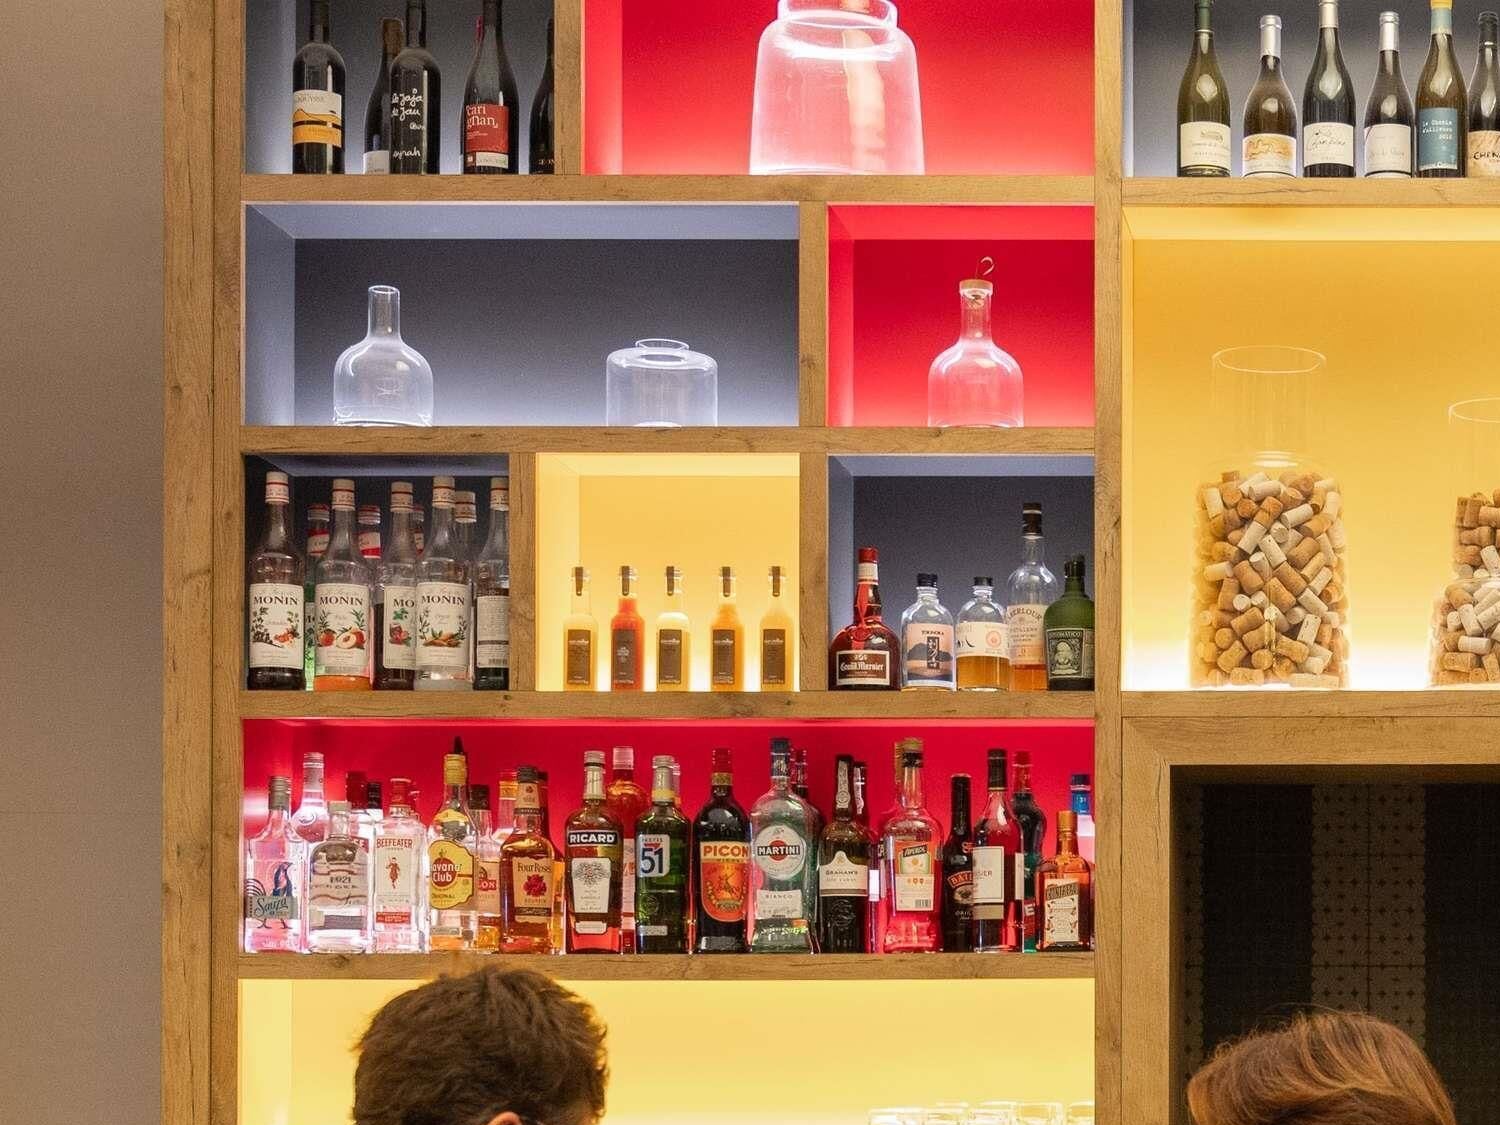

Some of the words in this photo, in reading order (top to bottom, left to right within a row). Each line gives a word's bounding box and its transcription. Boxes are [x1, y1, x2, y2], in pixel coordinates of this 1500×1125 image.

[254, 596, 298, 606] MONIN
[320, 596, 363, 606] MONIN
[422, 595, 465, 606] MONIN
[376, 838, 413, 849] BEEFEATER
[569, 833, 615, 844] RICARD
[703, 845, 749, 857] PICON
[758, 846, 800, 855] MARTINI
[640, 847, 664, 874] 51
[432, 863, 461, 872] avana
[433, 872, 453, 882] Club
[254, 897, 288, 917] Sauza
